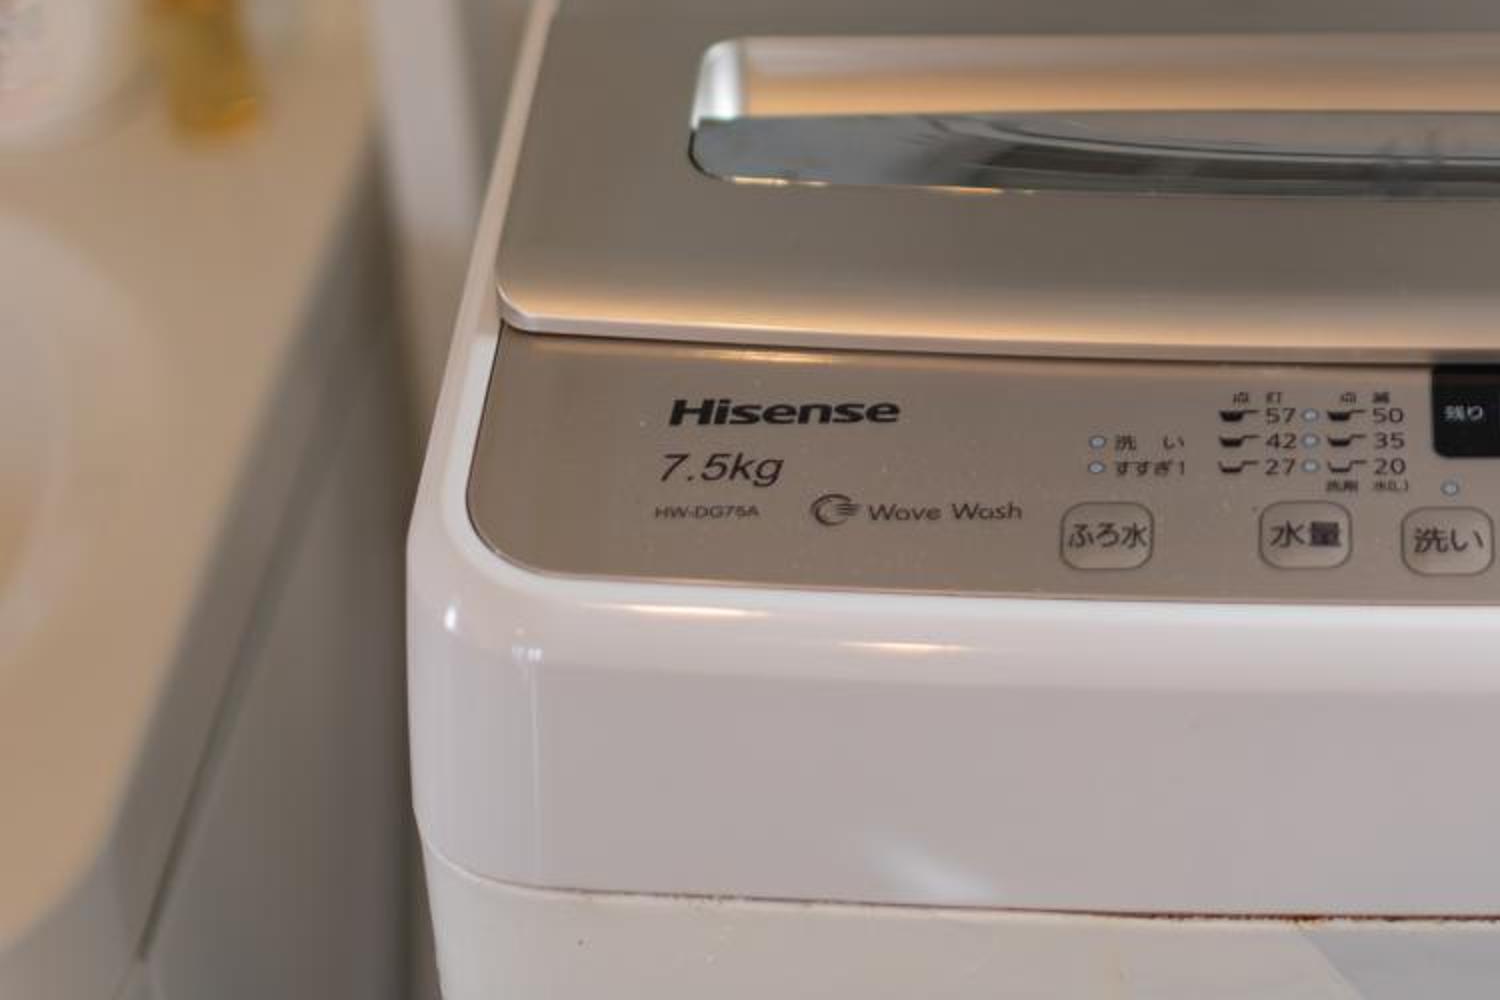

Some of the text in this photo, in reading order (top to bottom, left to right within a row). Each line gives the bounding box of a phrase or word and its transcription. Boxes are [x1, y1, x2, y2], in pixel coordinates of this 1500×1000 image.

[669, 400, 901, 425] Hisense
[1265, 408, 1296, 424] 57
[1372, 408, 1403, 423] 50
[1444, 405, 1483, 421] 残り
[1265, 433, 1297, 449] 42
[1374, 433, 1405, 449] 35
[660, 453, 784, 487] 7.5kg
[1265, 459, 1296, 476] 27
[1374, 459, 1406, 475] 20
[869, 502, 1023, 521] Wave Wash
[1069, 523, 1148, 549] ふろ水
[1270, 521, 1342, 548] 水量
[1413, 527, 1484, 552] 洗い
